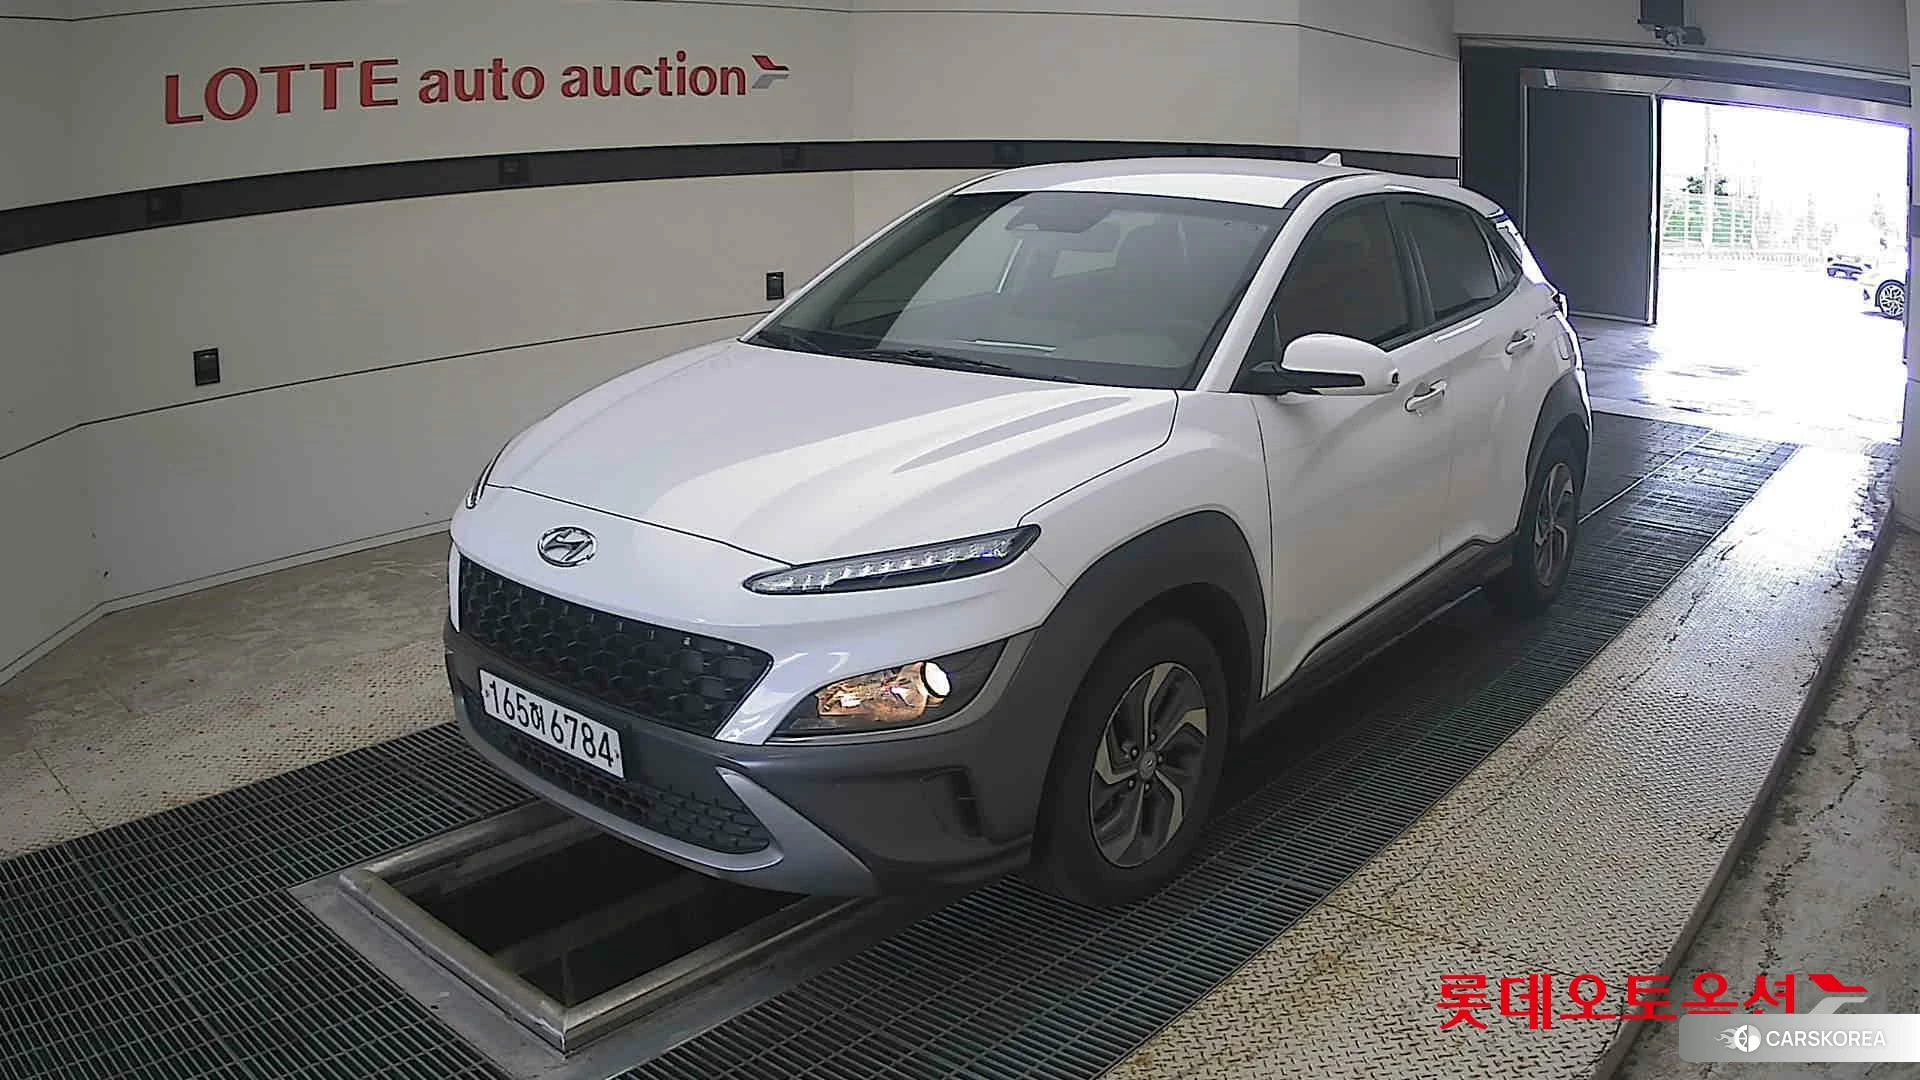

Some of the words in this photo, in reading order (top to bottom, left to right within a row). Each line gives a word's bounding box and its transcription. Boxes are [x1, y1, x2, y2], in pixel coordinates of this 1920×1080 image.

[164, 57, 399, 125] LOTTE
[419, 58, 545, 104] auto
[561, 50, 747, 98] auction
